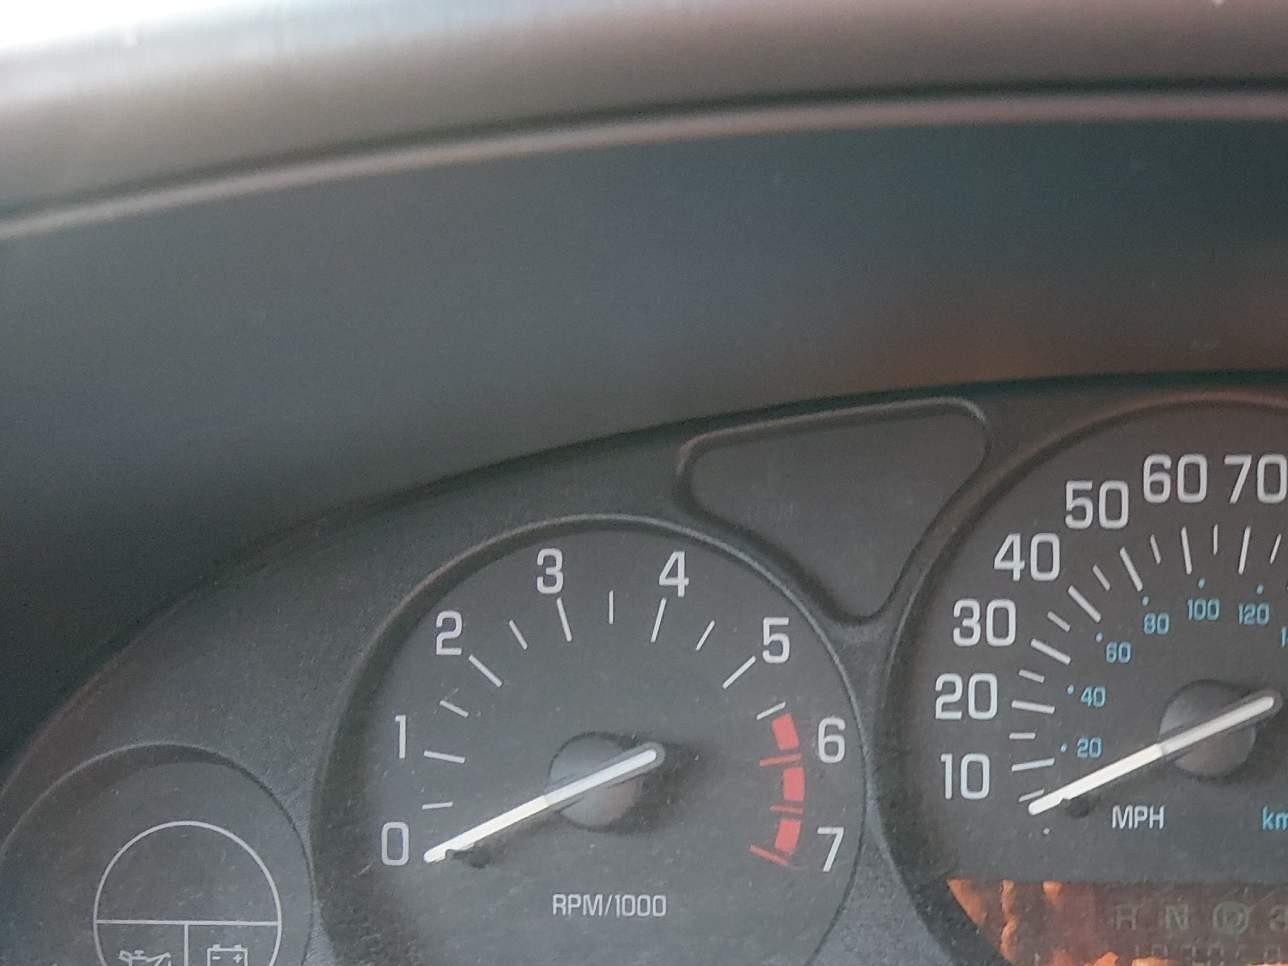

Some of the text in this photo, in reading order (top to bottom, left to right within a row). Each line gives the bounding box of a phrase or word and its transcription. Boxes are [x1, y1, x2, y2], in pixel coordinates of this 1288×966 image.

[1143, 454, 1208, 503] 60
[1224, 454, 1288, 504] 70
[1065, 480, 1129, 528] 50
[537, 548, 564, 594] 3
[659, 551, 690, 597] 4
[994, 533, 1060, 580] 40
[952, 600, 1016, 646] 30
[1143, 613, 1169, 635] 80
[1187, 599, 1219, 620] 100
[1238, 604, 1269, 625] 120
[436, 611, 463, 655] 2
[762, 617, 790, 663] 5
[1106, 643, 1131, 664] 60
[935, 674, 998, 720] 20
[1080, 689, 1106, 708] 40
[395, 714, 407, 758] 1
[817, 717, 846, 763] 6
[1077, 738, 1101, 758] 20
[940, 753, 990, 800] 10
[1112, 806, 1164, 829] MPH
[381, 822, 409, 866] 0
[816, 827, 846, 872] 7
[552, 894, 667, 918] RPM/1000
